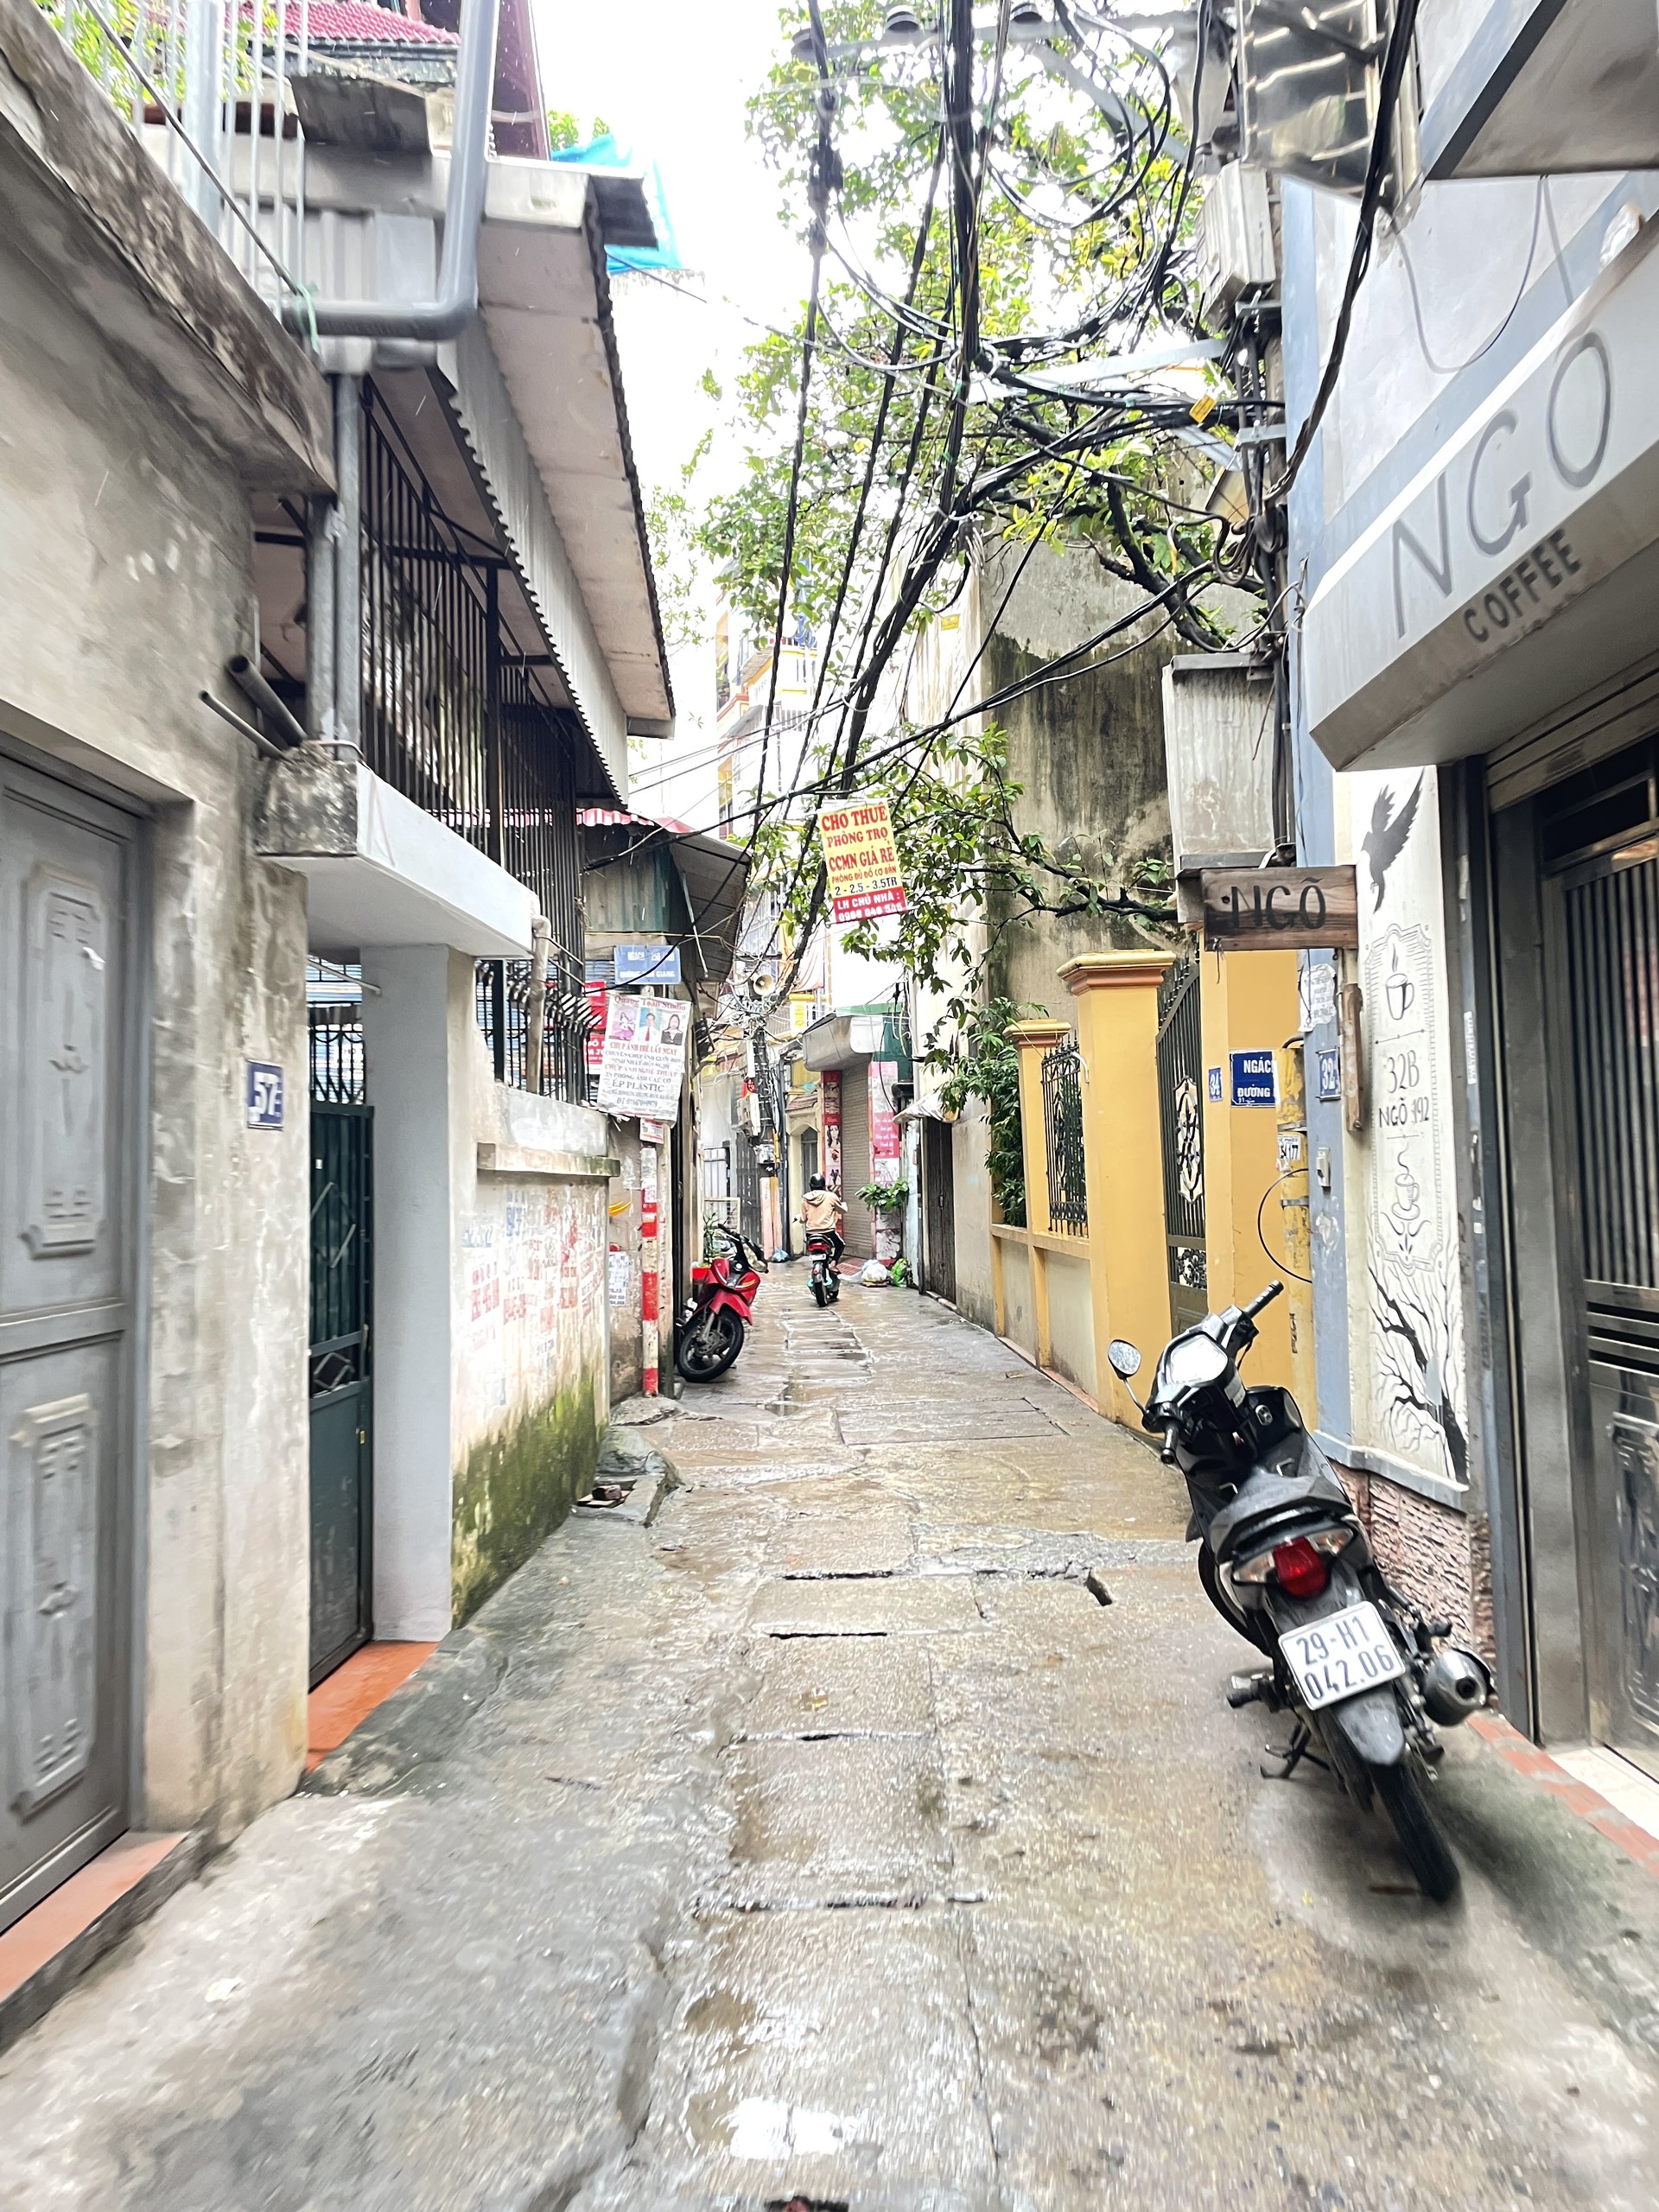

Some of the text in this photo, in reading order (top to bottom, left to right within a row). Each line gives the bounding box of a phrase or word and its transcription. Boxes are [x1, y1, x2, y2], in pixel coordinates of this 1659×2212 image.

[1462, 527, 1583, 643] COFFEE
[822, 802, 887, 831] CHO THUÊ
[827, 827, 888, 848] PHÒNG TRỌ
[829, 840, 894, 872] CCMN GIÁ RẺ
[837, 899, 849, 911] LH
[851, 893, 871, 907] CHỦ
[849, 882, 863, 894] 2.5
[1231, 876, 1326, 930] NGÕ
[626, 1081, 664, 1092] PLASTIC
[1210, 1071, 1220, 1096] 34
[1387, 1049, 1420, 1094] 32B
[251, 1071, 280, 1117] 57
[1237, 1084, 1270, 1097] ĐƯỜNG
[1379, 1096, 1430, 1128] NGÕ 192
[1297, 1616, 1370, 1666] 29-H1
[1304, 1644, 1395, 1700] 042.06
